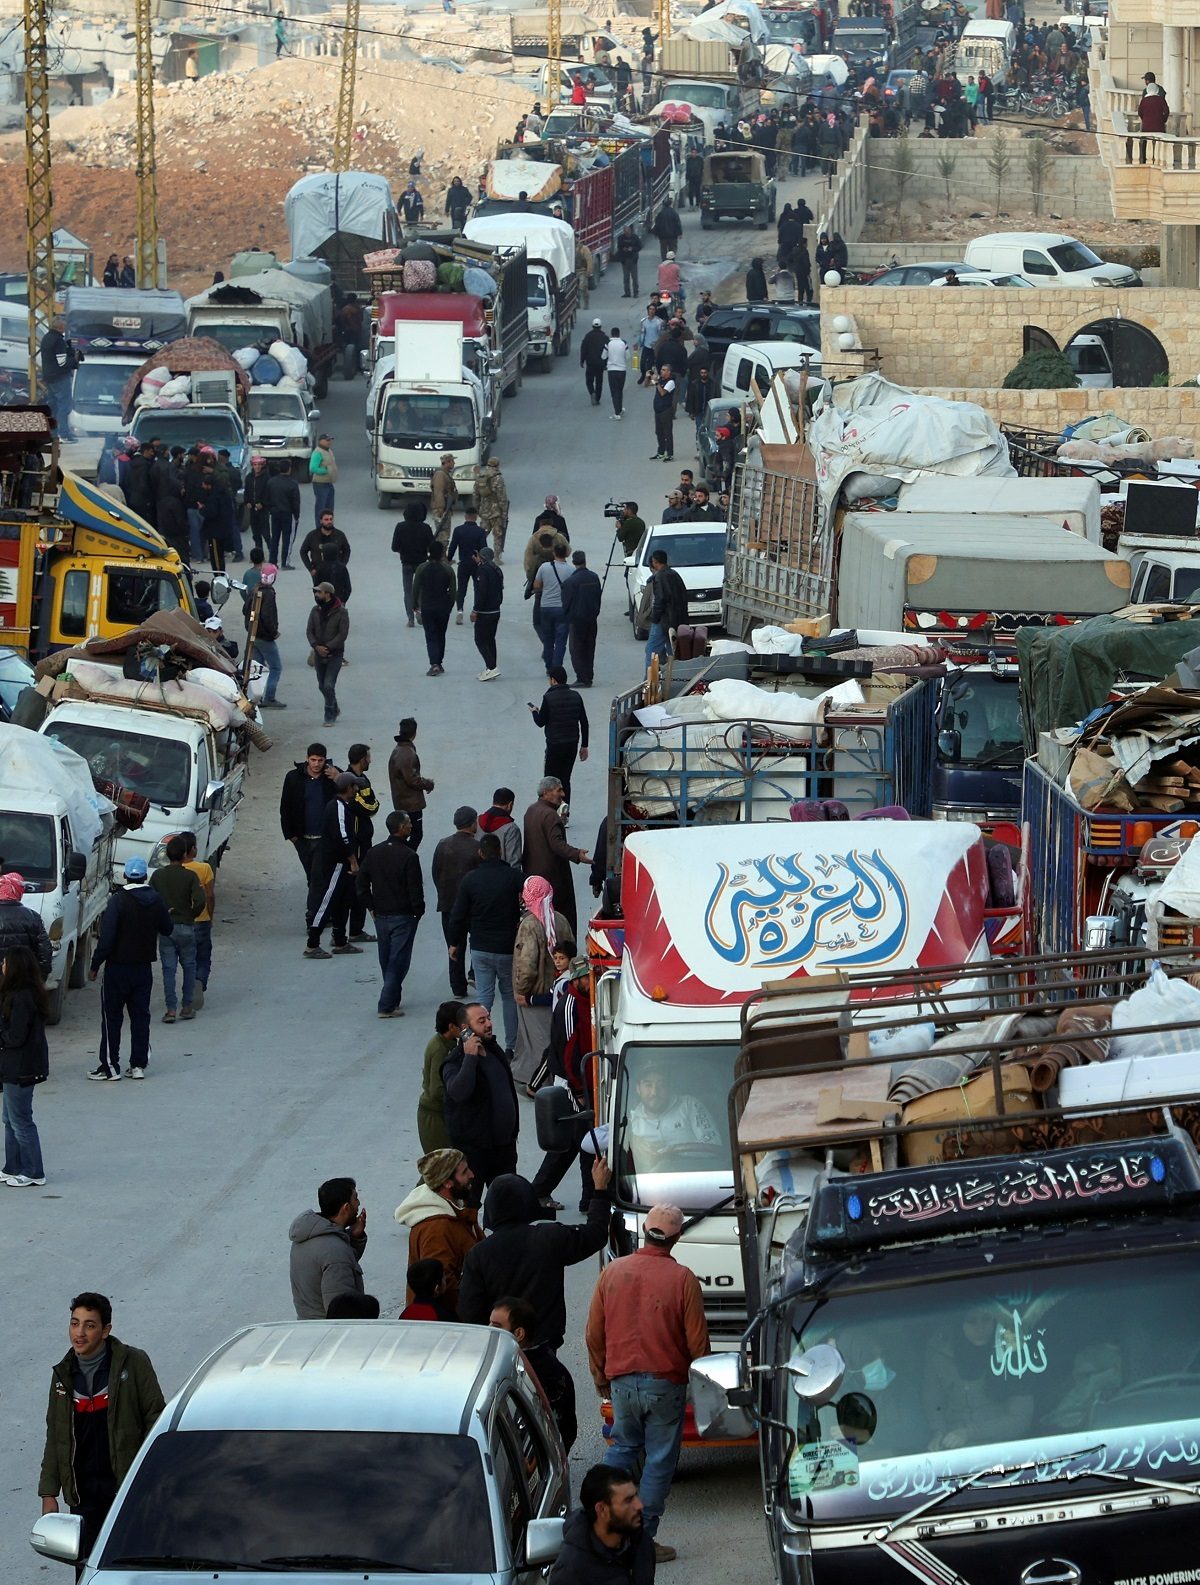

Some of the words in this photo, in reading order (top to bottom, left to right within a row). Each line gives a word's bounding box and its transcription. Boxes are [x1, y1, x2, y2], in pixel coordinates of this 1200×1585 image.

[997, 1166, 1062, 1207] الله
[1064, 1163, 1125, 1200] شاء
[1120, 1156, 1150, 1188] ما
[901, 1181, 996, 1222] تبارك
[990, 1308, 1048, 1381] الله
[823, 1447, 842, 1455] JAPAN
[1108, 1437, 1146, 1470] نور
